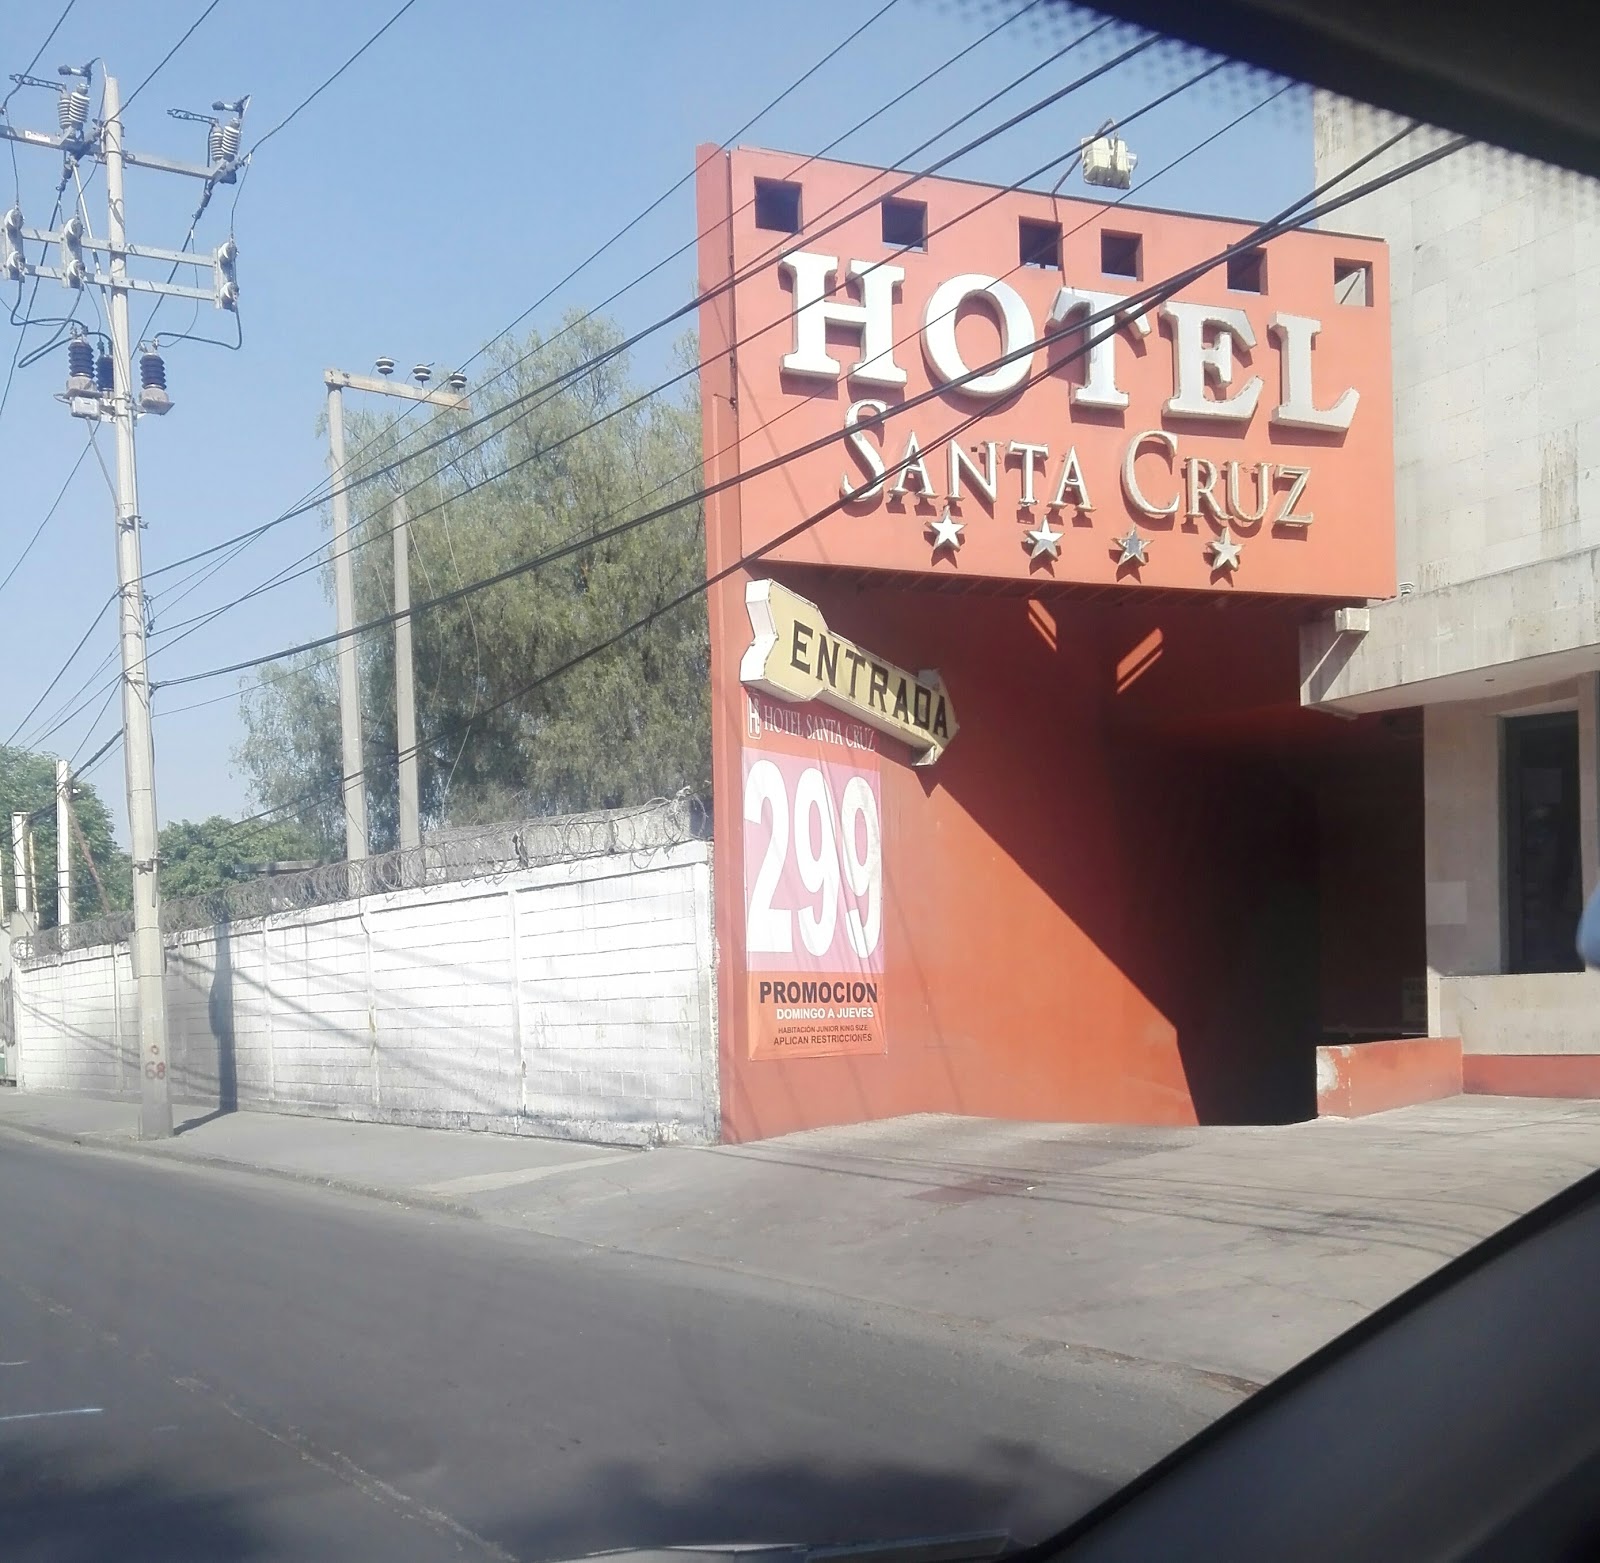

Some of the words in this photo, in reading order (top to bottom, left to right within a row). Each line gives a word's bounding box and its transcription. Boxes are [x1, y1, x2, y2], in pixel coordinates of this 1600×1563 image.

[779, 247, 1360, 434] HOTEL
[840, 399, 1096, 511] SANTA
[1121, 429, 1314, 527] CRUZ
[790, 619, 949, 740] ENTRADA
[763, 705, 803, 737] HOTEL
[806, 714, 844, 746] SANTA
[845, 724, 876, 752] CRUZ
[743, 759, 882, 959] 299
[759, 981, 878, 1004] PROMOCION
[776, 1008, 825, 1020] DOMINGO
[827, 1009, 835, 1019] A
[837, 1007, 875, 1019] JUEVES
[816, 1025, 839, 1033] JUNIOR
[773, 1036, 809, 1046] APLICAN
[811, 1033, 873, 1044] RESTRICCIONES
[145, 1060, 166, 1080] 68
